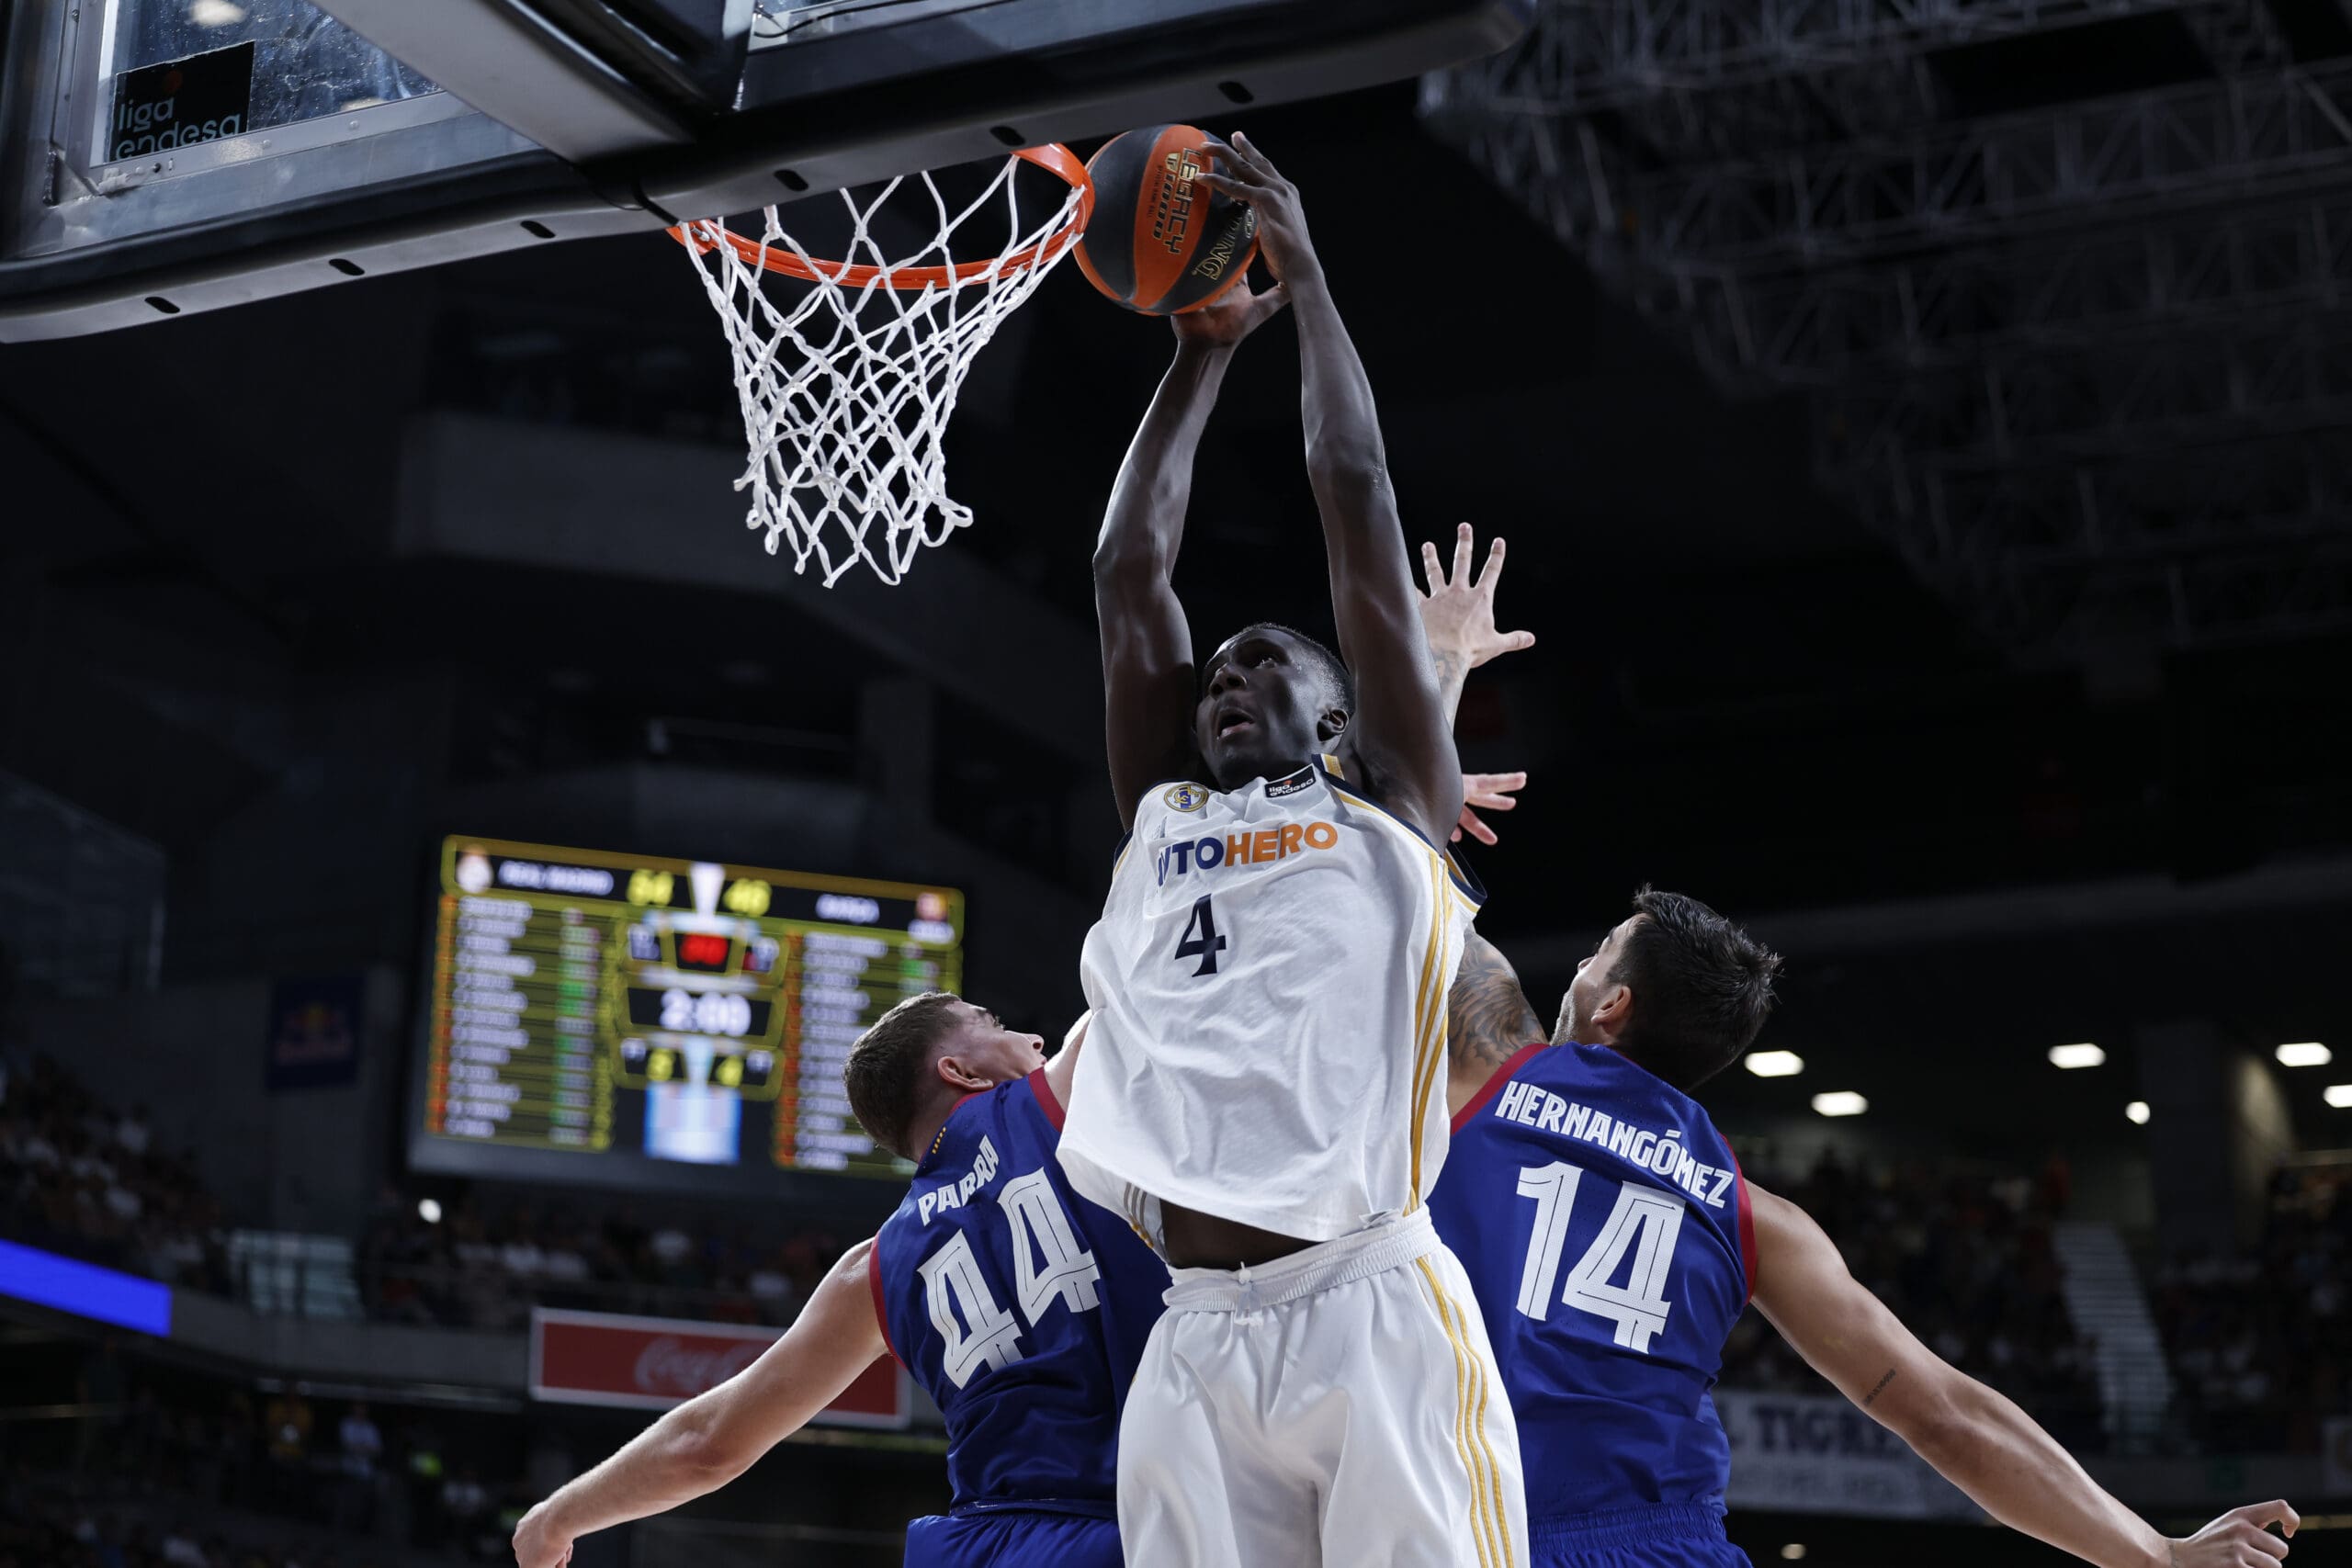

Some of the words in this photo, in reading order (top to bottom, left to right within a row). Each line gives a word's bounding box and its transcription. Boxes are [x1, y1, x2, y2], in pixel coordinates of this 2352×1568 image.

[116, 113, 241, 160] endesa
[118, 96, 175, 132] liga
[1163, 147, 1202, 254] LEGACY
[1269, 784, 1291, 793] liga
[1270, 778, 1314, 796] endesa
[1174, 893, 1227, 978] 4
[918, 1134, 1000, 1226] PARRA
[1495, 1080, 1735, 1209] HERNANGÓMEZ
[917, 1166, 1102, 1391] 44
[1516, 1160, 1687, 1355] 14
